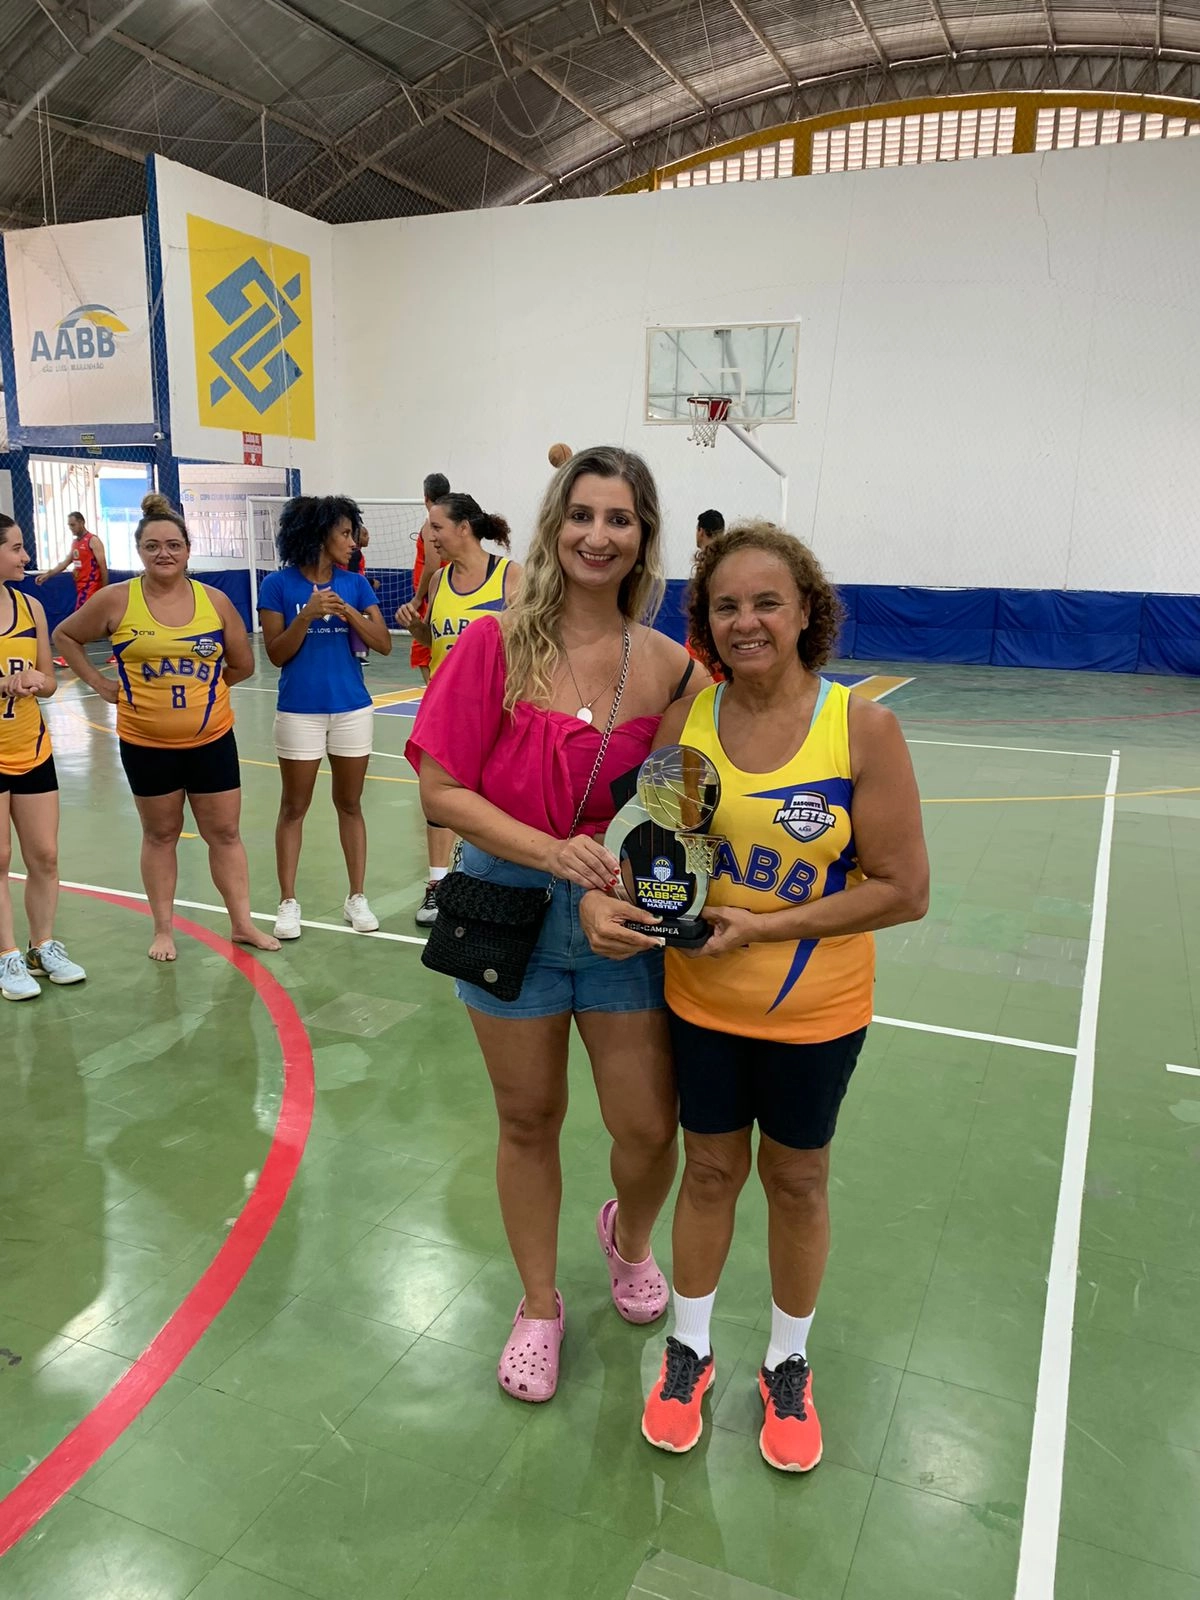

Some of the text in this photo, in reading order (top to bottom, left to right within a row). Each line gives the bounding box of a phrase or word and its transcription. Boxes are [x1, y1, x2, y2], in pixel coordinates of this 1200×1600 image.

[31, 326, 115, 362] AABB
[141, 656, 211, 682] AABB
[171, 684, 187, 709] 8
[793, 800, 821, 808] BASQUETE
[774, 808, 836, 826] MASTER
[710, 840, 818, 904] ABB
[638, 881, 687, 894] IX COPA
[642, 897, 683, 907] BASQUETE
[647, 902, 678, 911] MASTER
[627, 922, 680, 935] ICE-CAMPEÃ
